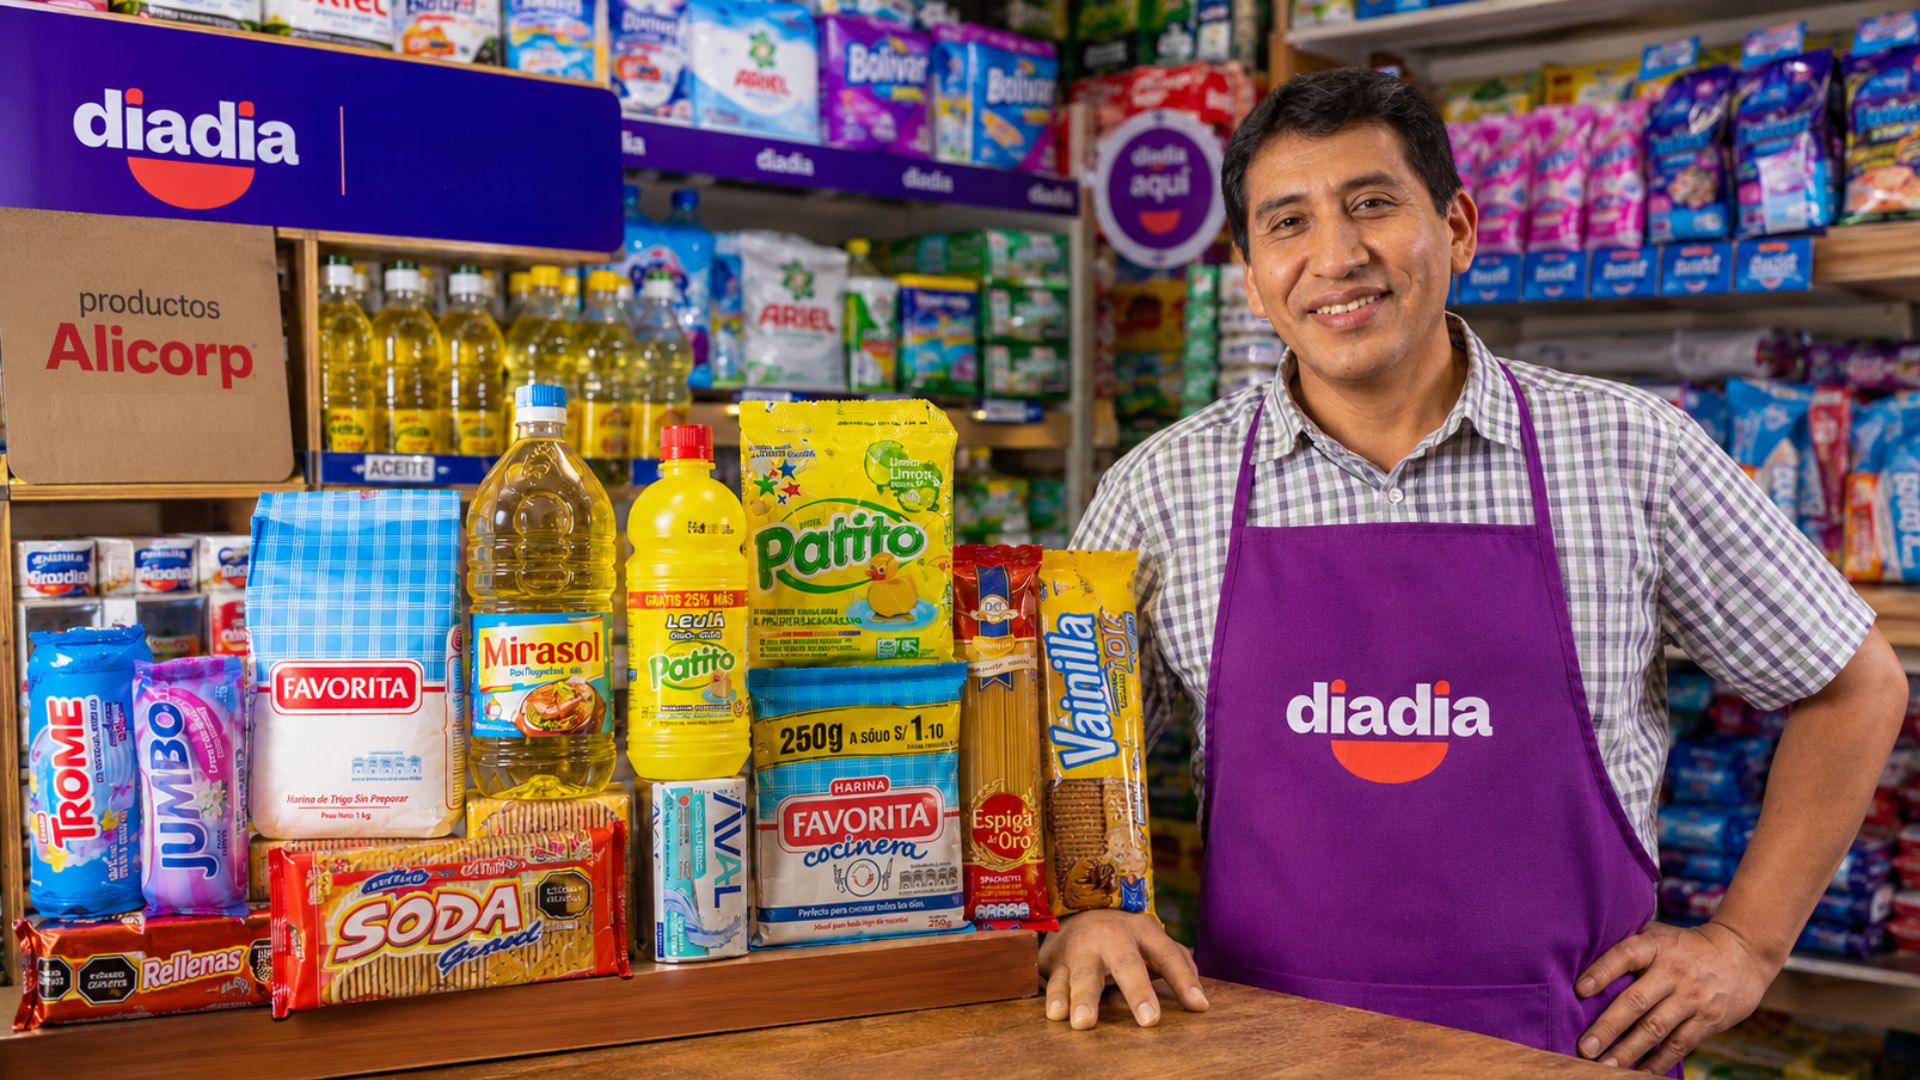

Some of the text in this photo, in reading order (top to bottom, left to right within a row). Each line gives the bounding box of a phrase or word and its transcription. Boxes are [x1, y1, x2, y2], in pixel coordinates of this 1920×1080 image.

[73, 87, 300, 166] diadia
[79, 288, 221, 319] productos
[759, 303, 837, 335] ARIEL
[46, 322, 254, 389] Alicorp
[369, 459, 431, 478] ACEITE
[754, 511, 926, 592] Patito
[483, 631, 600, 670] Mirasol
[649, 646, 736, 690] Patito
[282, 676, 409, 699] FAVORITA
[1047, 614, 1118, 767] Vainilla
[1286, 678, 1494, 738] diadia
[780, 722, 844, 755] 250g
[46, 697, 98, 849] TROME
[147, 701, 219, 879] JUMBO
[834, 780, 886, 793] HARINA
[317, 794, 329, 804] de
[330, 794, 353, 806] Trigo
[792, 803, 931, 838] FAVORITA
[973, 809, 1033, 834] Espiga
[998, 831, 1032, 849] Oro
[712, 792, 748, 909] AVAL
[803, 835, 928, 868] cocinera
[335, 883, 523, 962] SODA
[142, 949, 243, 990] Rellenas
